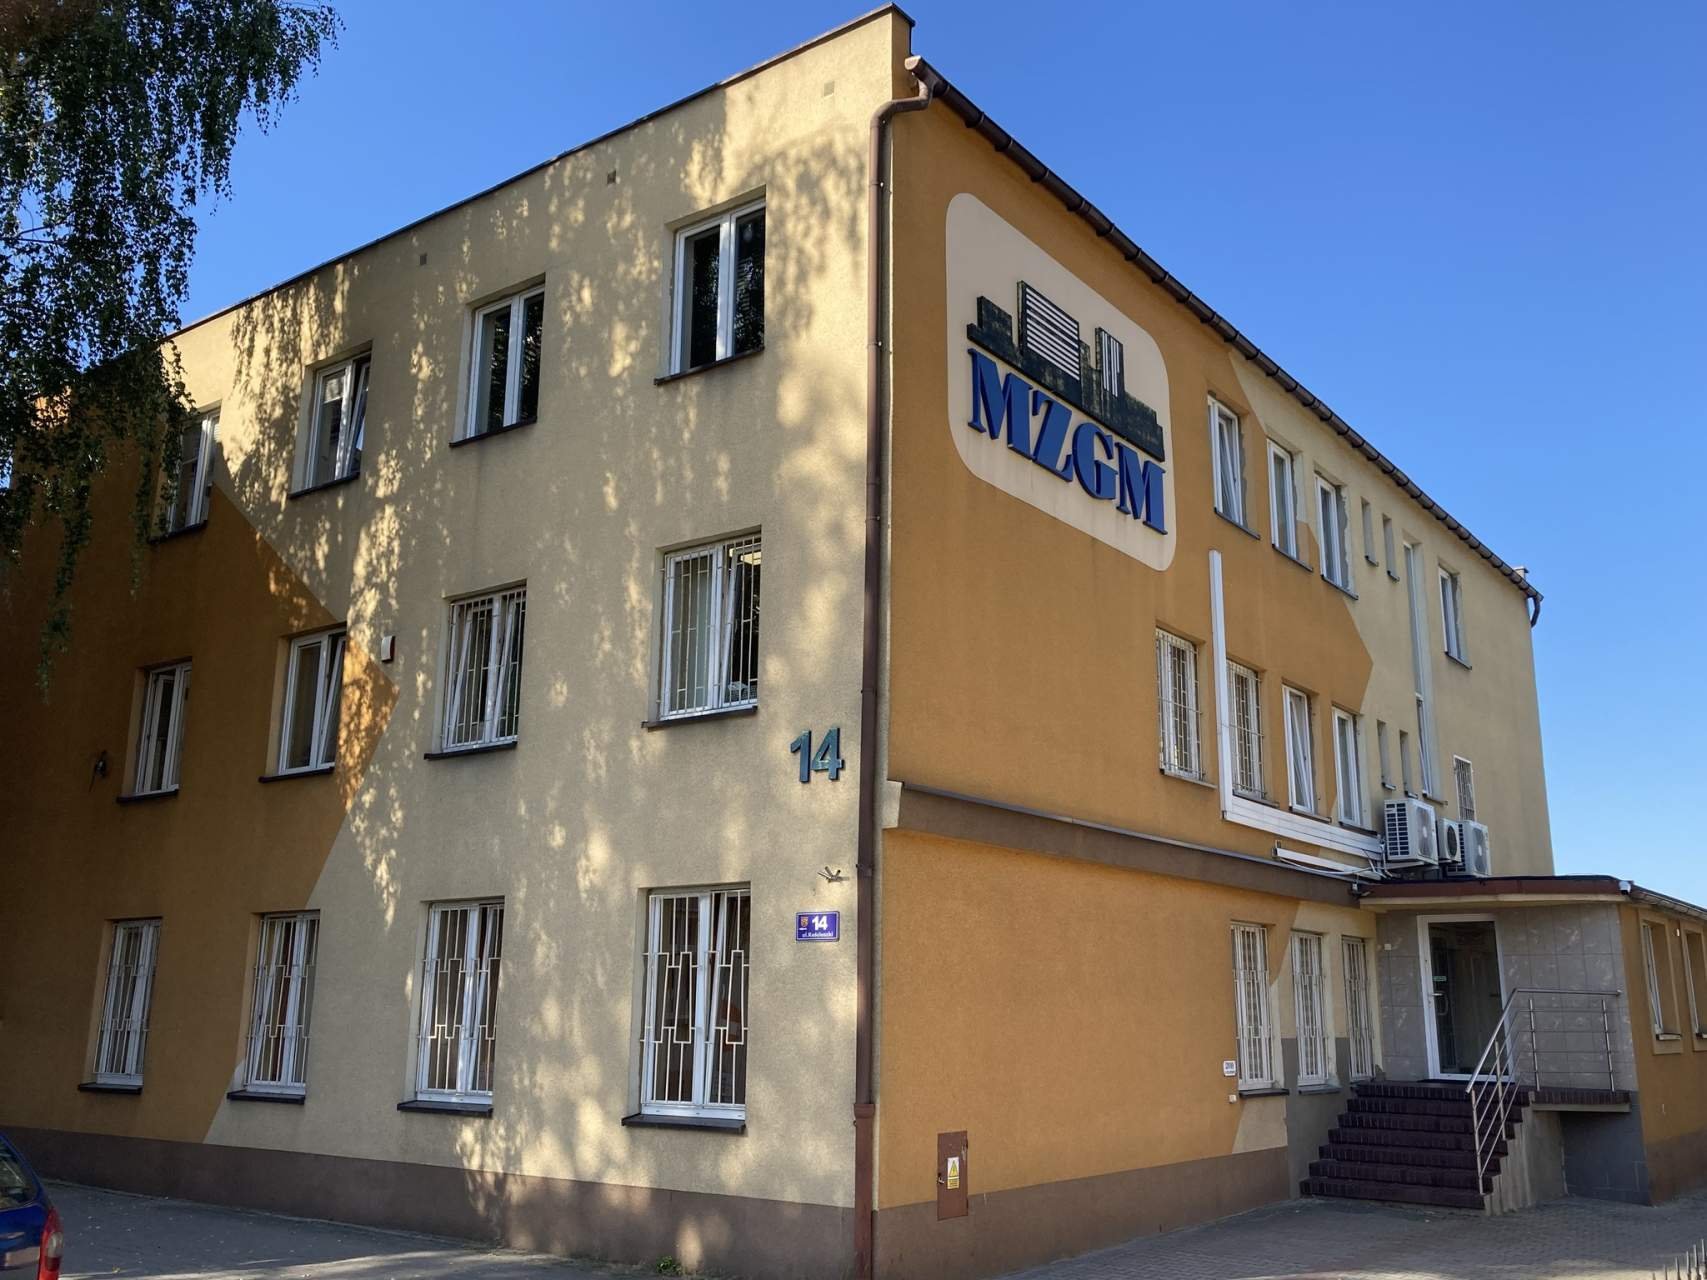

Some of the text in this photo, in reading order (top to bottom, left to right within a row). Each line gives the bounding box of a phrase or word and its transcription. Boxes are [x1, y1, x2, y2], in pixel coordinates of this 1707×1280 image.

[967, 348, 1168, 535] MZGM
[790, 727, 845, 783] 14
[811, 915, 829, 931] 14
